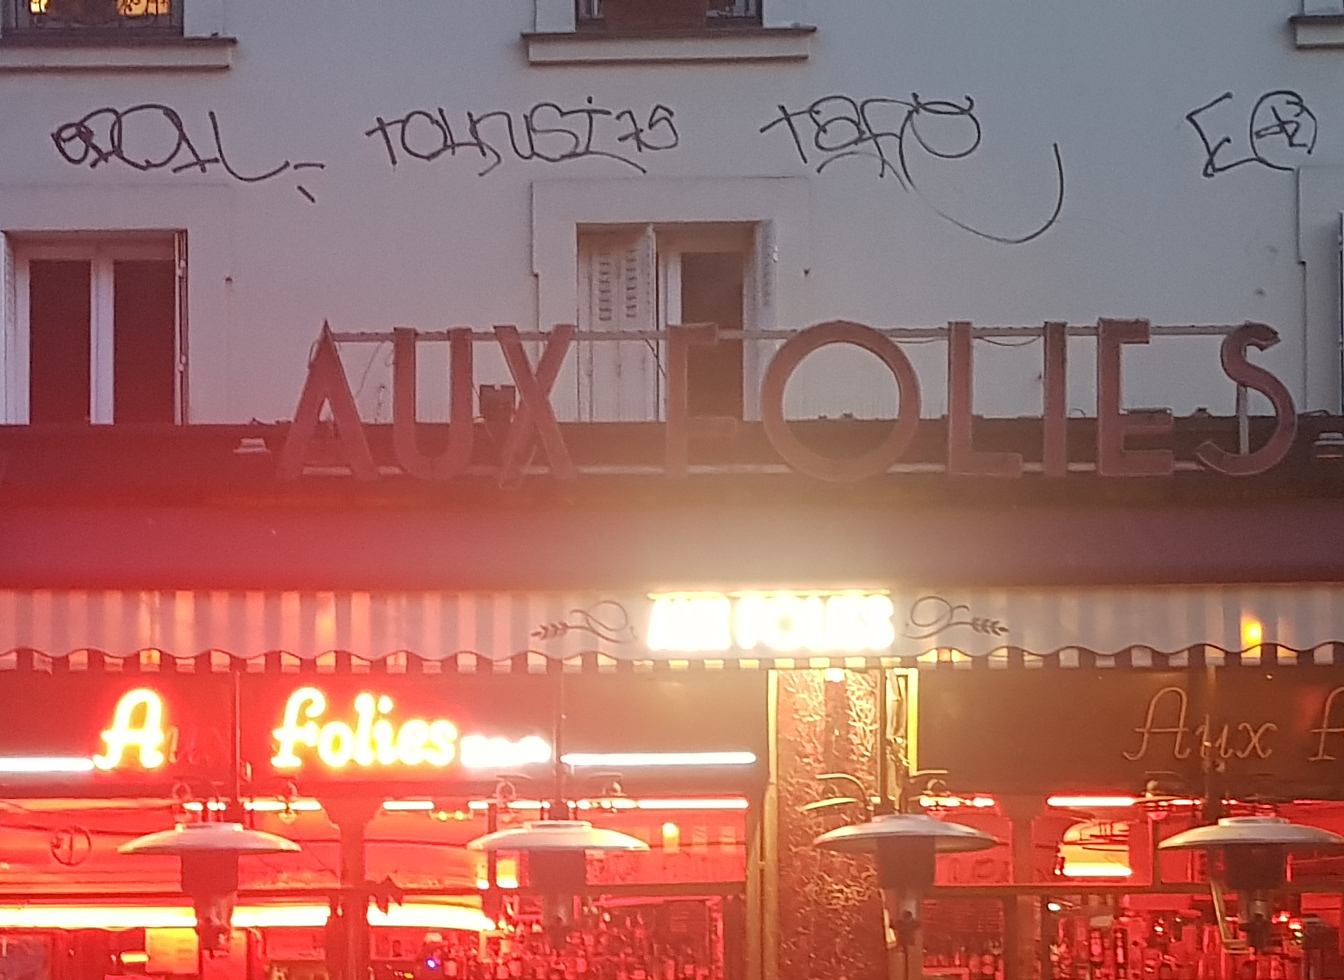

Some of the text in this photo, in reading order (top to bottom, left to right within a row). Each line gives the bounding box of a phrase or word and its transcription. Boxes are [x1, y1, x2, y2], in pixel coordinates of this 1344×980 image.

[273, 318, 1298, 483] AUX FOLIES
[1123, 686, 1278, 761] Aux
